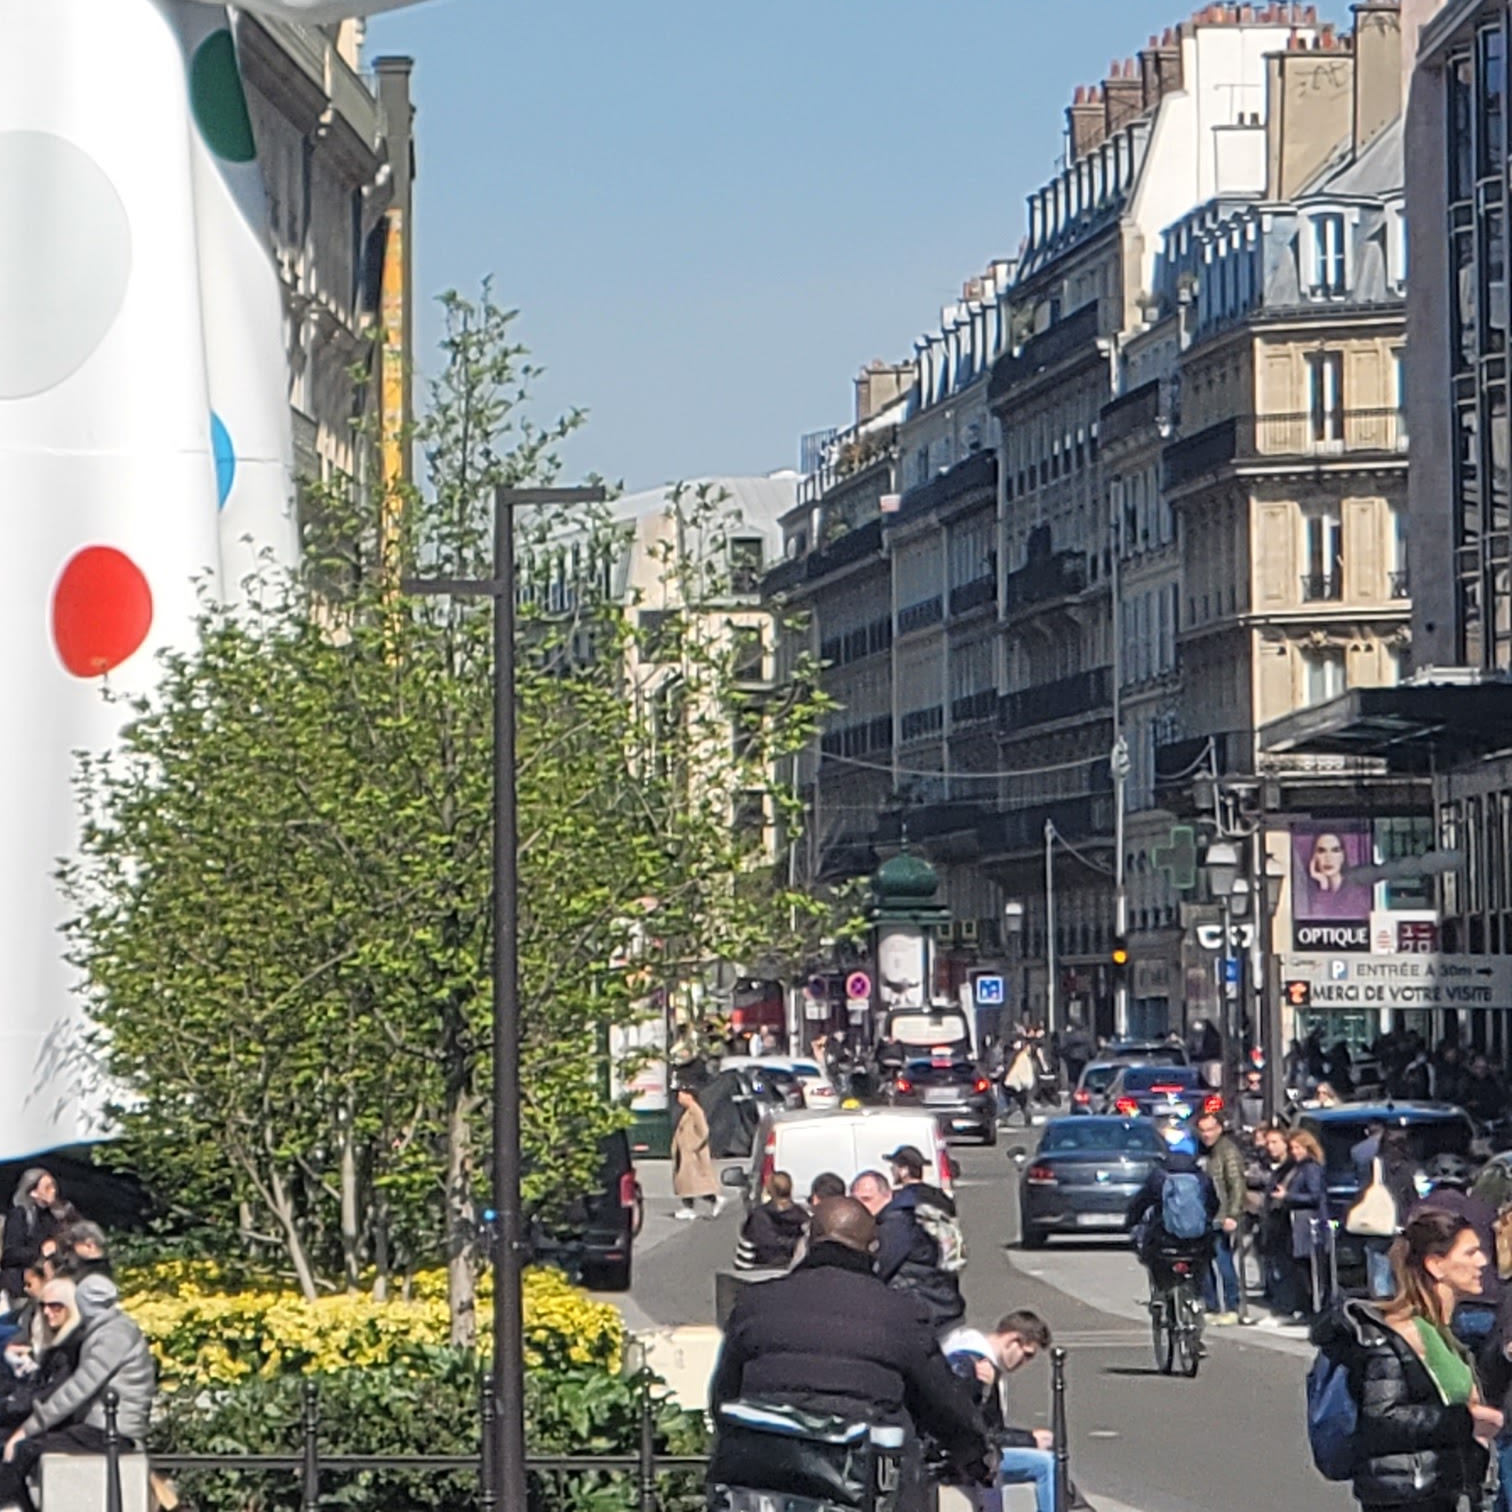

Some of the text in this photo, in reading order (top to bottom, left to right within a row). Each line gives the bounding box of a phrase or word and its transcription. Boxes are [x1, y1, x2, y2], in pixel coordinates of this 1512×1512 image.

[1298, 927, 1369, 947] OPTIQUE
[1332, 960, 1345, 980] P
[1356, 962, 1420, 976] ENTRÉE
[1313, 985, 1493, 1002] MERCI DE VOTRE VISITE
